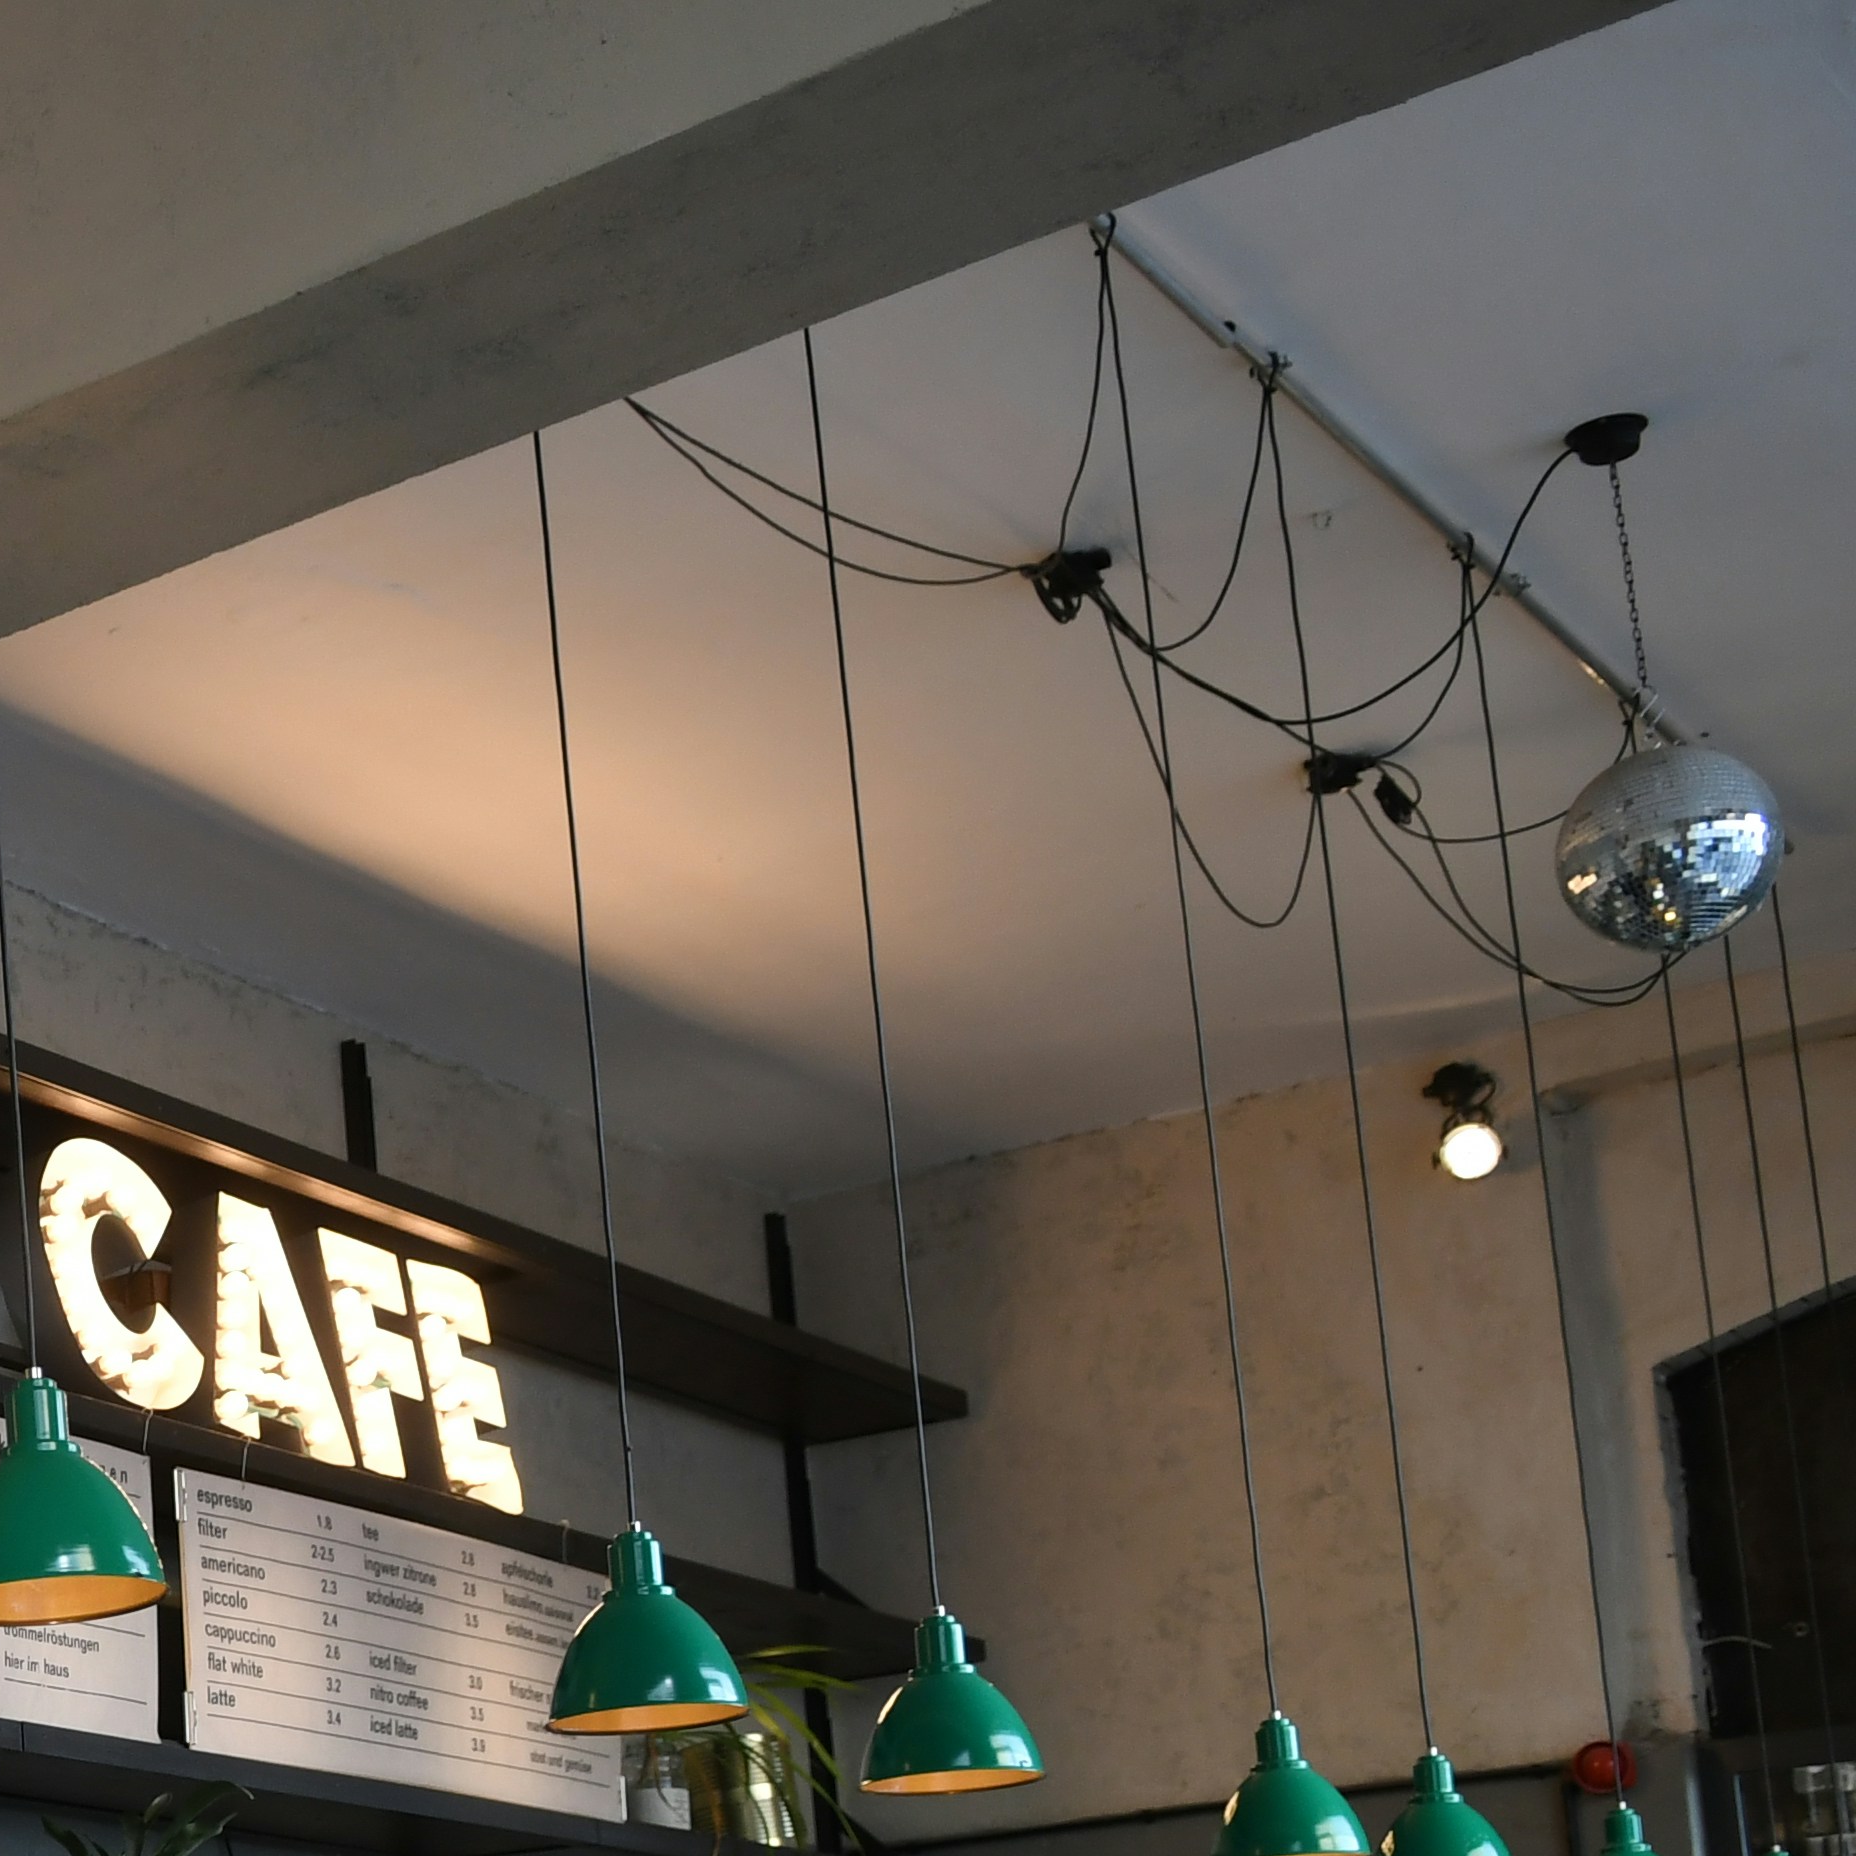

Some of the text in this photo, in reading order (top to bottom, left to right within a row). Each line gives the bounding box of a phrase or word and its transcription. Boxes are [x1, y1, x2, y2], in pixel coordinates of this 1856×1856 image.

[38, 1137, 524, 1516] CAFE
[196, 1488, 253, 1513] espresso
[197, 1517, 228, 1540] filter
[361, 1522, 380, 1542] tee
[200, 1556, 338, 1596] americano 2.3
[202, 1586, 338, 1628] piccolo 2.4
[366, 1587, 424, 1616] schokolade
[204, 1623, 276, 1649] cappuccino
[4, 1651, 25, 1671] hier
[43, 1657, 70, 1678] haus
[207, 1651, 342, 1694] flat white 3.2
[368, 1650, 391, 1672] iced
[393, 1655, 418, 1676] filter
[207, 1685, 342, 1726] latte 3.4
[369, 1683, 394, 1704] nitro
[396, 1689, 429, 1711] coffee
[369, 1714, 393, 1736] iced
[394, 1719, 419, 1741] latte
